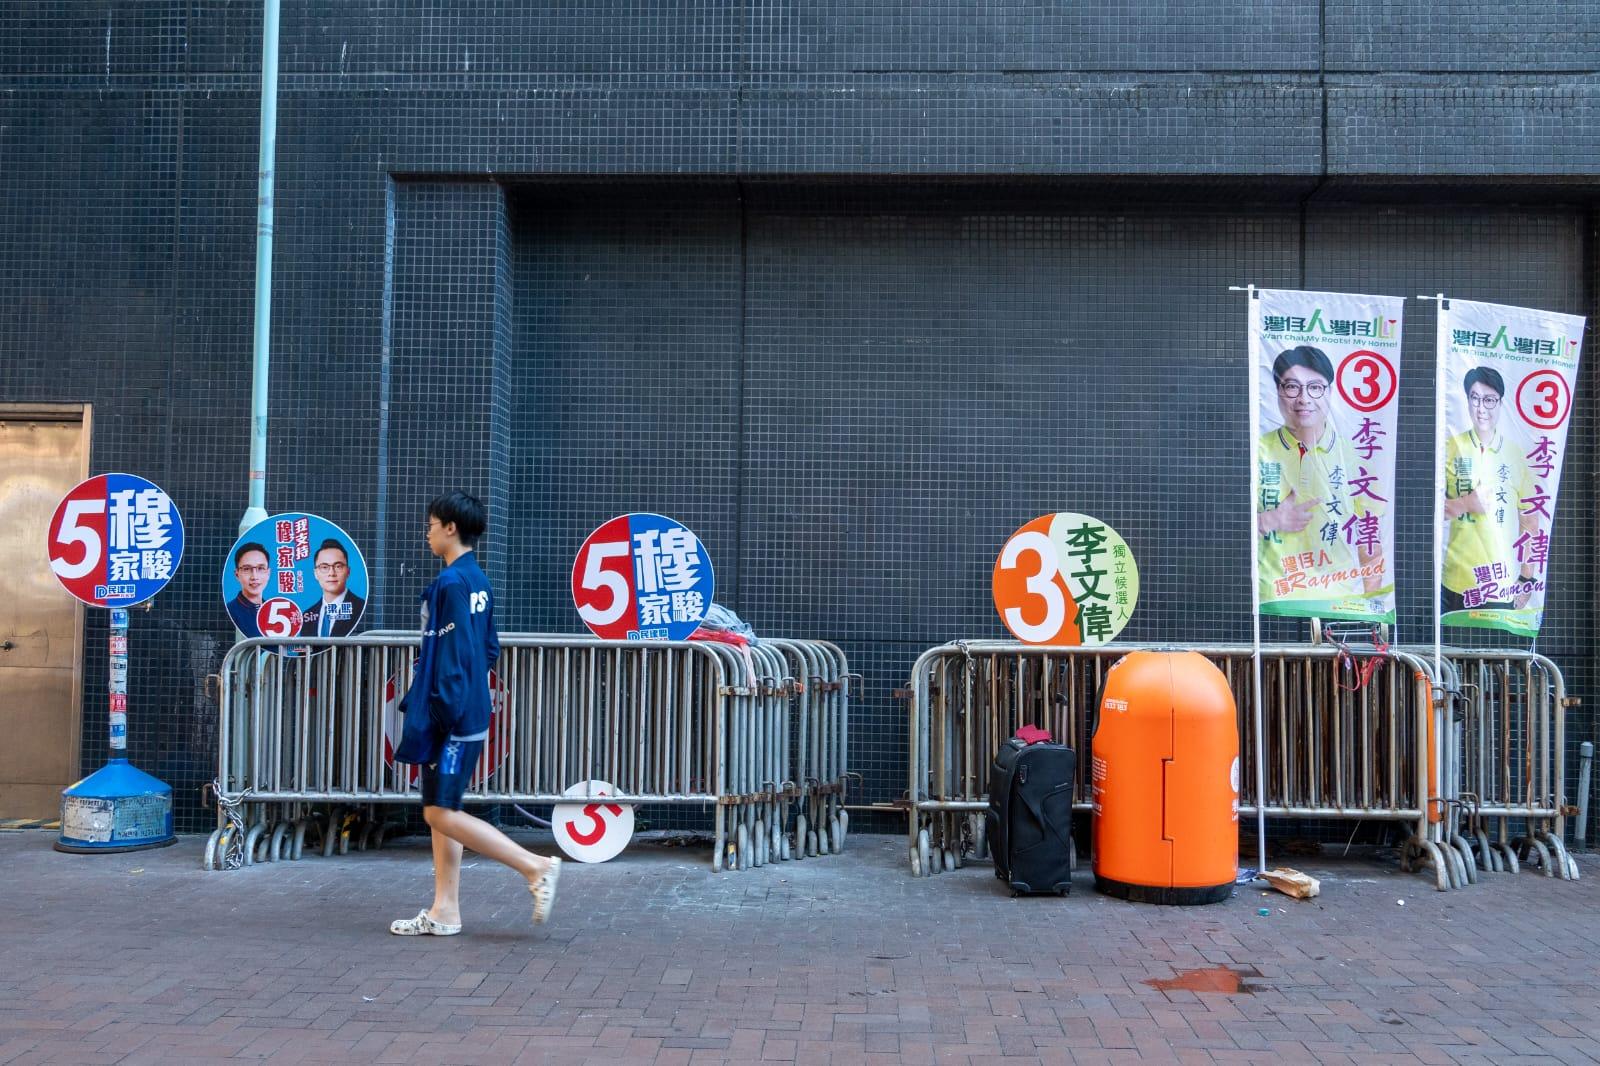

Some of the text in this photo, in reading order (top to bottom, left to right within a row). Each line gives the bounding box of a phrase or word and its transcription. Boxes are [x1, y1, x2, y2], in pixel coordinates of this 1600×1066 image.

[1262, 333, 1282, 341] Wan
[1322, 336, 1350, 345] Roots!
[1353, 339, 1366, 347] My
[1535, 357, 1550, 365] My
[1353, 359, 1381, 404] 3
[1533, 381, 1559, 419] 3
[1320, 465, 1345, 546] 李文偉
[1342, 417, 1388, 555] 李文偉
[1496, 464, 1511, 527] 李文偉
[1513, 436, 1558, 574] 李文偉
[50, 499, 106, 579] 5
[276, 520, 296, 593] 穆家駿
[295, 518, 309, 560] 我支持
[578, 541, 630, 625] 5
[1001, 531, 1065, 643] 3
[1066, 523, 1113, 643] 李文偉
[1113, 545, 1128, 620] 獨立候選人
[265, 602, 291, 638] 5
